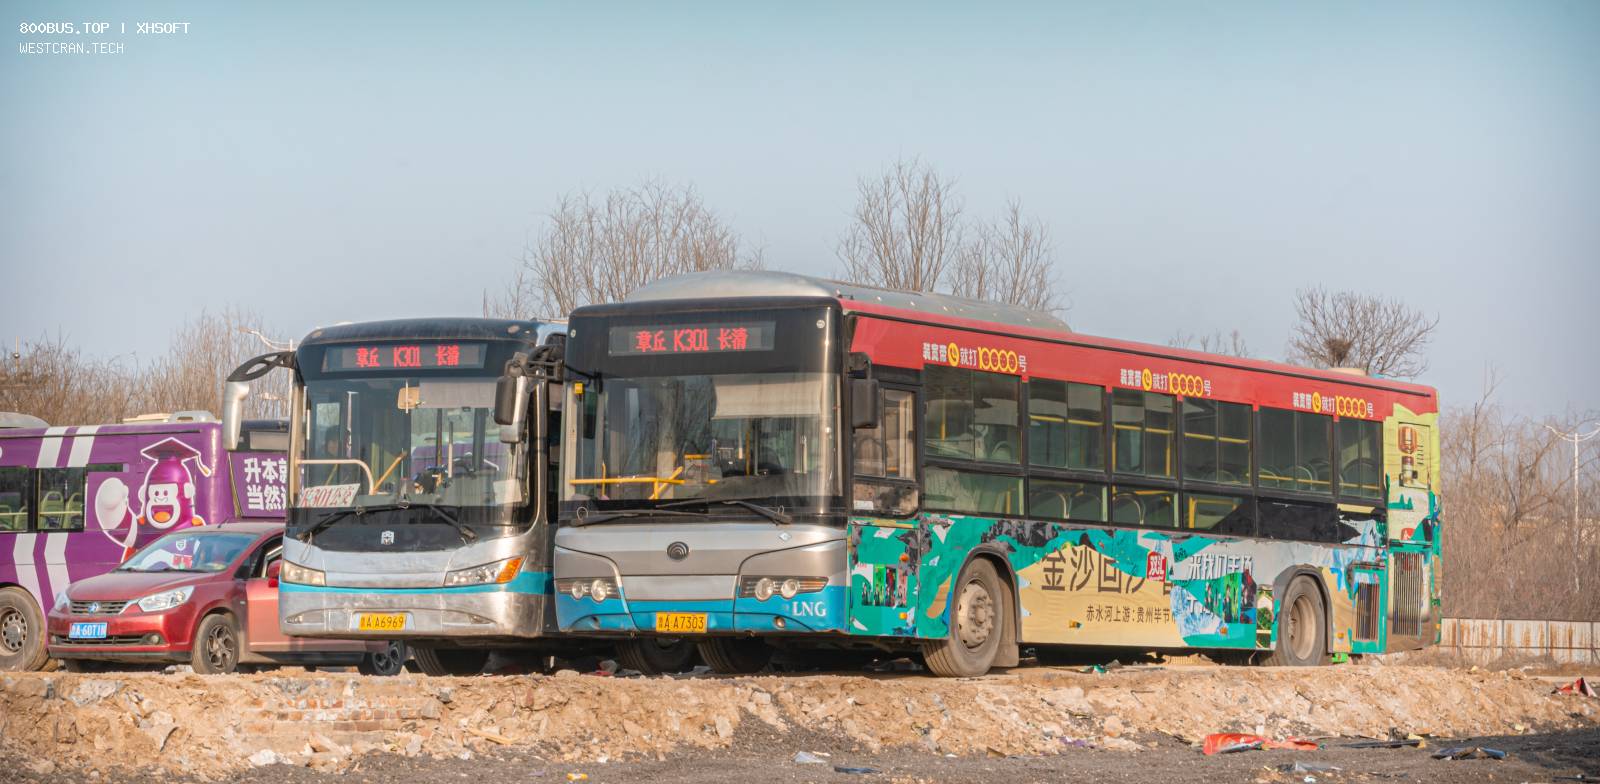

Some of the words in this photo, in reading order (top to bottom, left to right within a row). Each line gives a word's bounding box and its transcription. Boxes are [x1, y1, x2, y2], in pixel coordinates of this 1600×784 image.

[635, 330, 666, 352] 章丘
[673, 328, 709, 352] K301
[718, 327, 748, 351] 长清
[393, 346, 421, 368] K301
[792, 602, 827, 617] LNG
